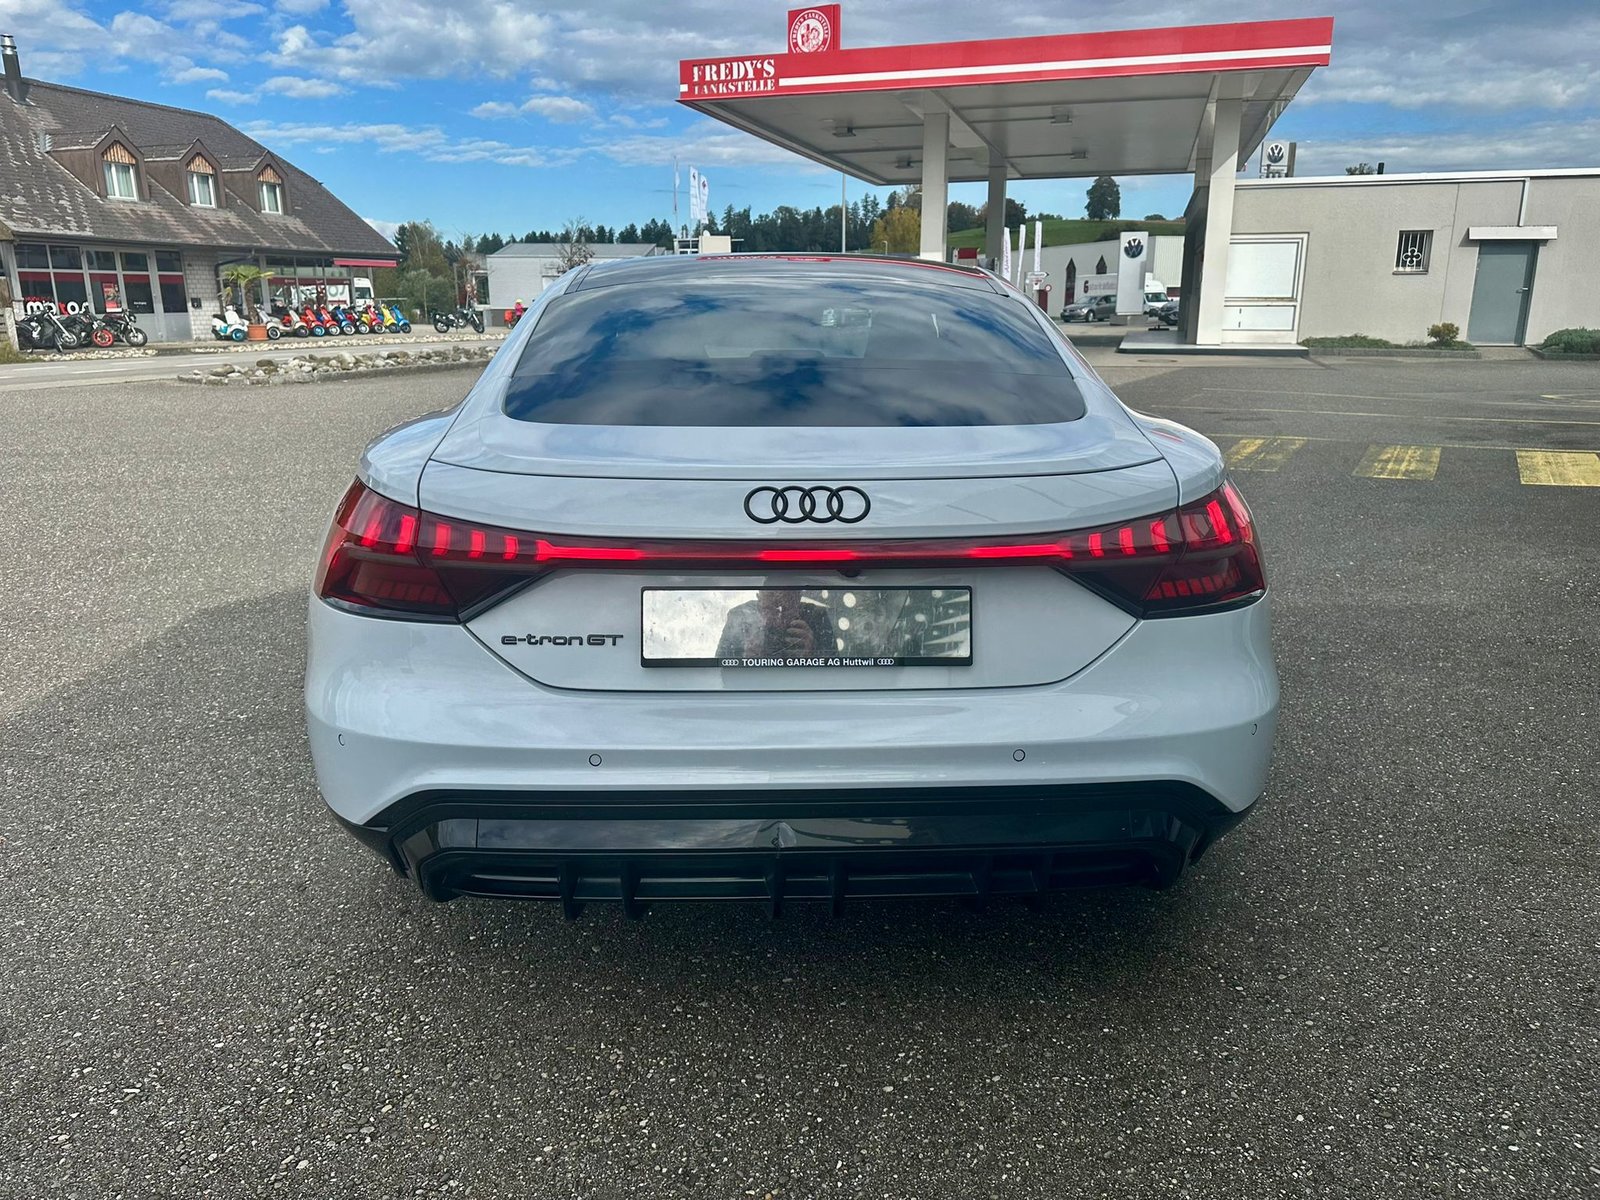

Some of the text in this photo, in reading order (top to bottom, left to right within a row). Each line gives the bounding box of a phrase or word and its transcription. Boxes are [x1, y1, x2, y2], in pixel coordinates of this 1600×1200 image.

[693, 59, 775, 82] FREDY'S
[694, 79, 775, 95] TANKSTELLE
[501, 633, 624, 646] e-tron GT
[742, 657, 874, 667] TOURING GARAGE AG Huttwil
